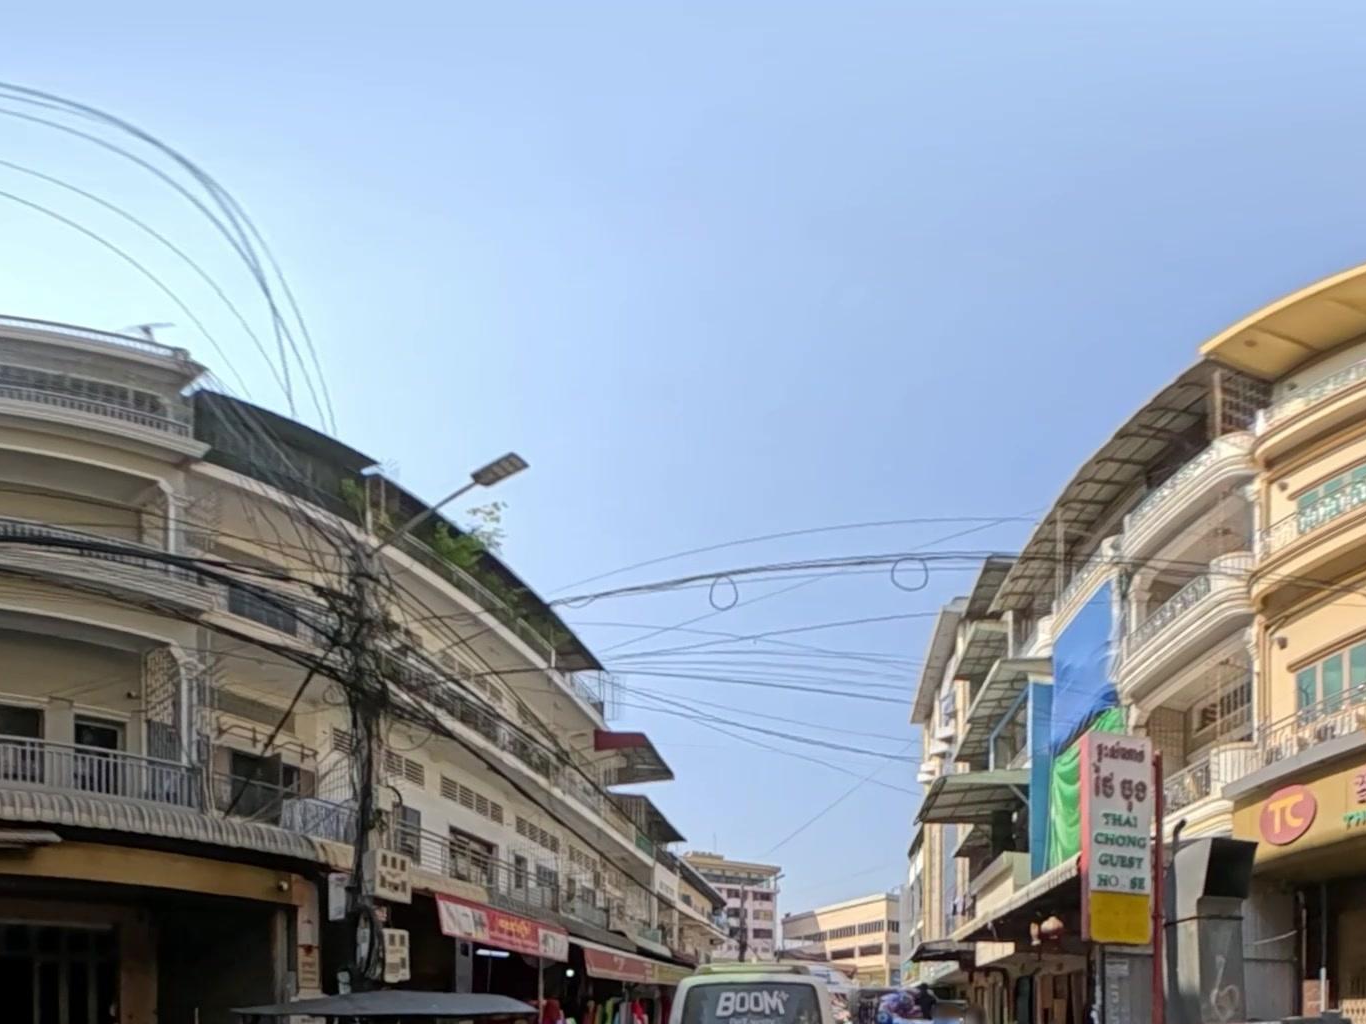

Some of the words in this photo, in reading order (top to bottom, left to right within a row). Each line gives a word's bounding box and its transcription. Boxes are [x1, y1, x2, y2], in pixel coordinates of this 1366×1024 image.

[1102, 812, 1137, 829] THAI
[1268, 792, 1304, 834] TC
[1094, 832, 1147, 849] CHONG
[1098, 855, 1144, 870] GUEST
[1097, 873, 1146, 890] HOSE
